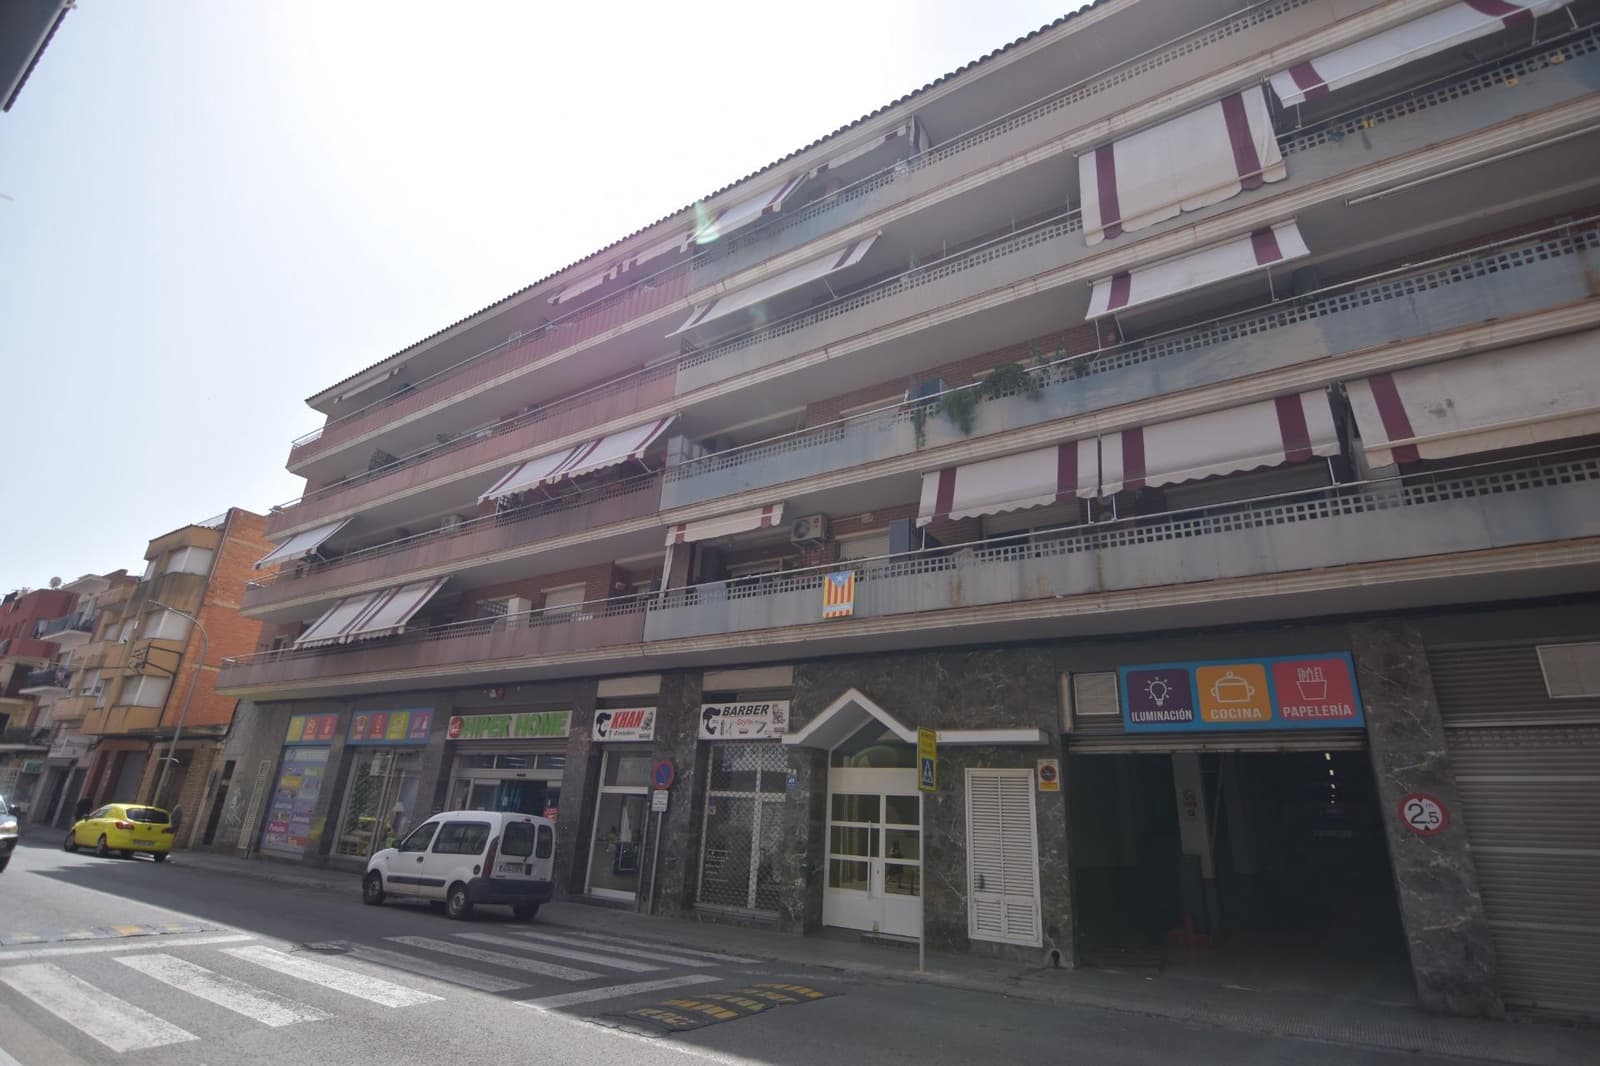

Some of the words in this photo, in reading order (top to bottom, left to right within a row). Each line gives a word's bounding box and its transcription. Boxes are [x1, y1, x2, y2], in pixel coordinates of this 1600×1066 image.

[722, 704, 769, 716] BARBER
[1131, 707, 1192, 722] ILUMINACIÓN
[1211, 707, 1262, 720] COCINA
[1283, 703, 1352, 718] PAPELERÍA
[611, 711, 645, 729] KHAN
